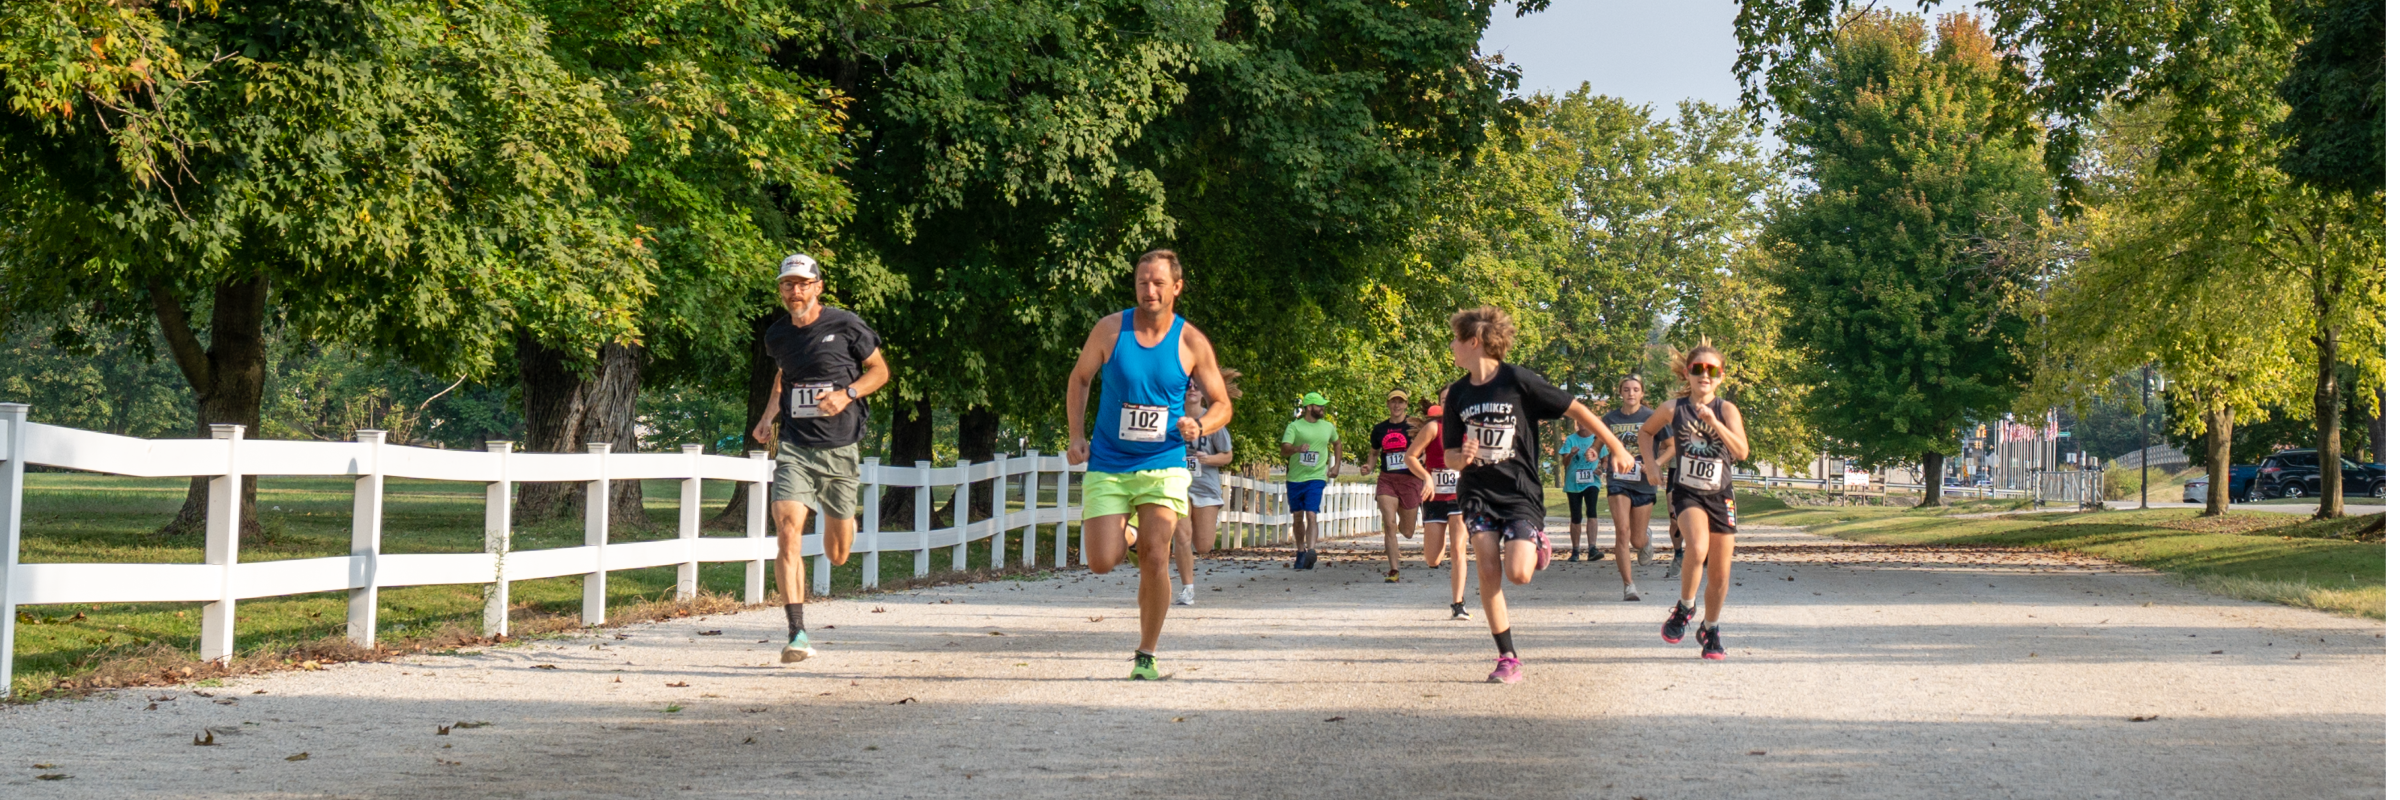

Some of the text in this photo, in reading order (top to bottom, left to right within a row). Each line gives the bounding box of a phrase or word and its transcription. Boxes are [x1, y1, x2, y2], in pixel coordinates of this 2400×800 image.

[1482, 402, 1513, 414] MIKE'S
[1129, 410, 1159, 428] 102
[1475, 428, 1505, 446] 107
[1303, 453, 1316, 462] 104
[1390, 454, 1404, 464] 112
[1688, 460, 1715, 478] 108
[1436, 472, 1456, 485] 103
